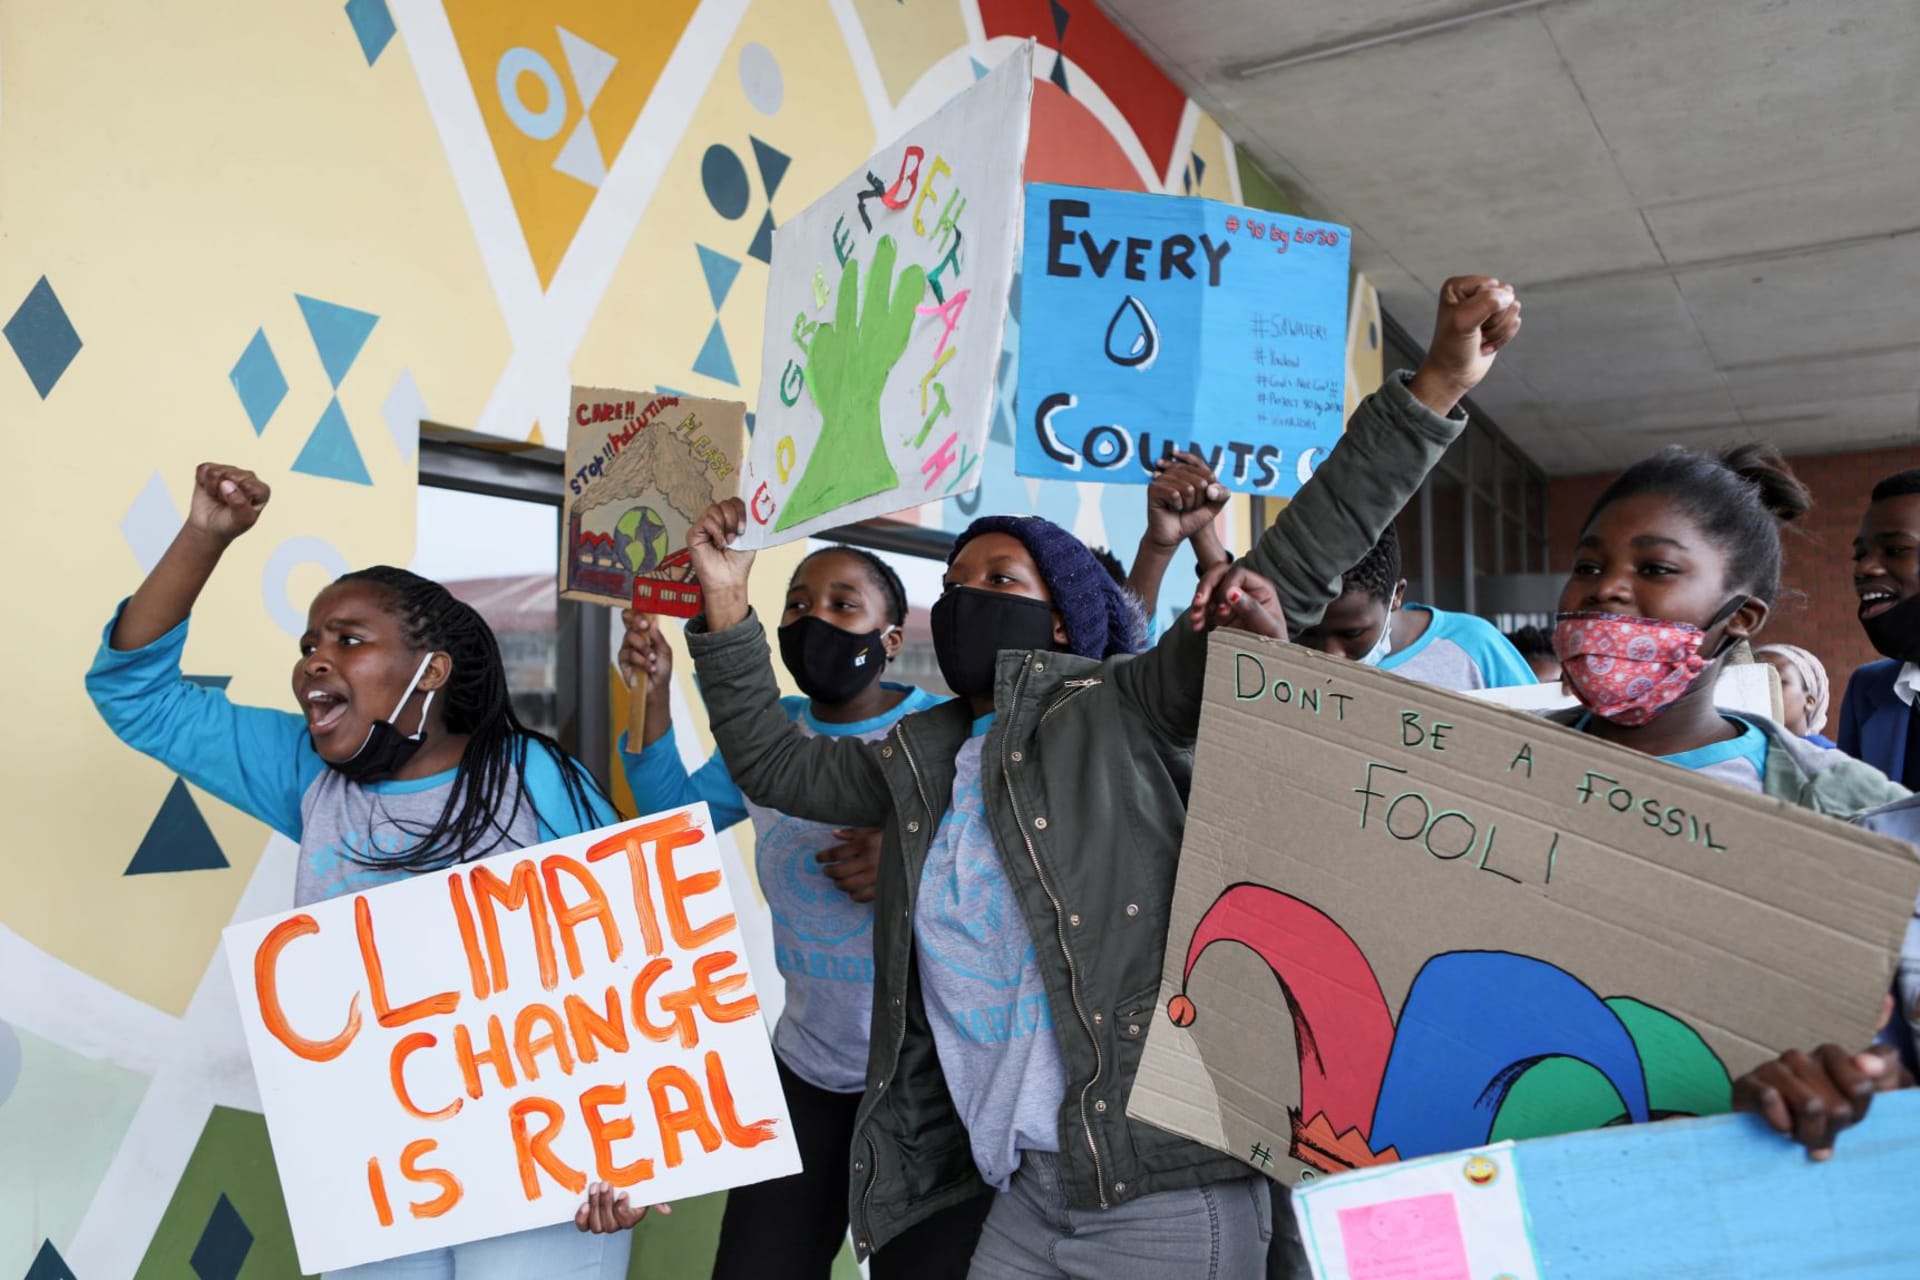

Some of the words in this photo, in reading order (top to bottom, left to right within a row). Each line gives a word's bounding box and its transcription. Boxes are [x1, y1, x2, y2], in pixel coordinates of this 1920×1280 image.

[881, 145, 951, 238] BE
[1047, 199, 1232, 287] EVERY
[1270, 223, 1290, 254] by
[1294, 226, 1340, 247] 2030
[676, 411, 735, 481] PLEASE
[750, 435, 796, 525] GO
[1400, 710, 1454, 751] BE
[1505, 742, 1534, 779] A
[1576, 770, 1728, 853] FOSSIL
[253, 810, 738, 1063] CLIMATE
[389, 950, 761, 1121] CHANGE
[366, 1137, 465, 1228] IS
[508, 1049, 781, 1201] REAL
